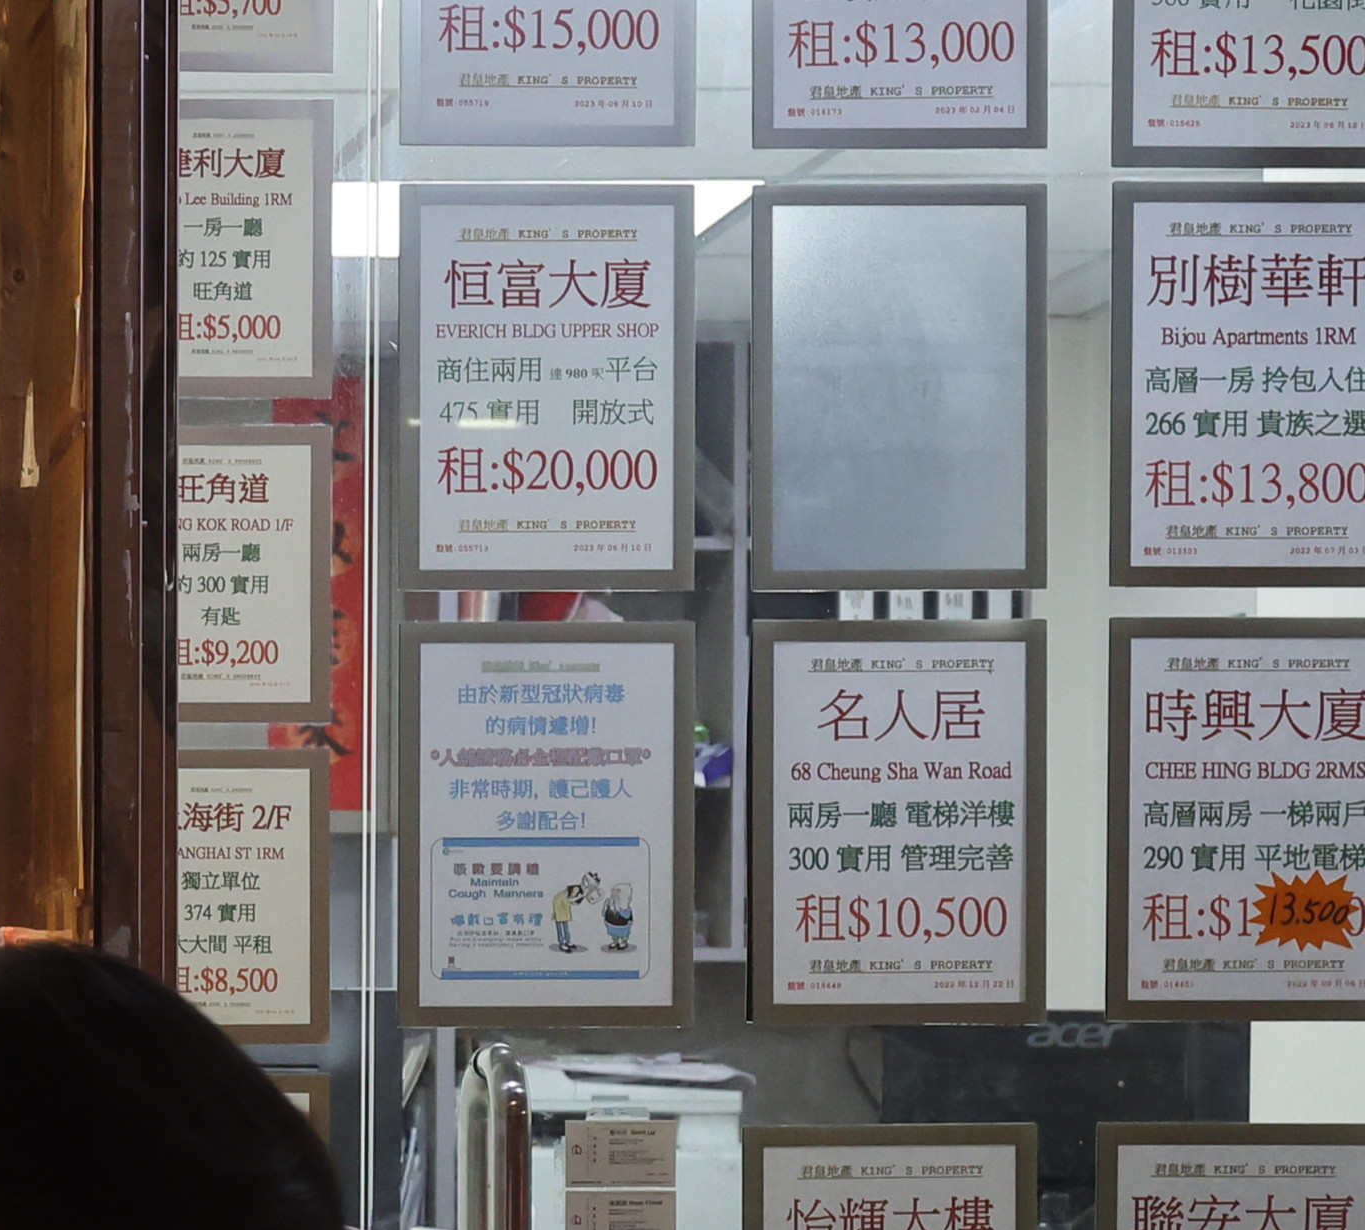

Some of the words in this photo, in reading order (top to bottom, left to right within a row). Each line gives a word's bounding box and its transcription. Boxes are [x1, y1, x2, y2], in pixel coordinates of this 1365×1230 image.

[577, 75, 638, 86] PROPERTY
[444, 259, 651, 309] 恒富大廈
[435, 323, 507, 339] EVERICH
[512, 323, 556, 339] BLDG
[561, 323, 611, 338] UPPER
[617, 323, 659, 339] SHOP
[1161, 327, 1206, 347] Bijou
[1213, 327, 1308, 348] Apartments
[1315, 327, 1356, 345] 1RM
[1145, 412, 1185, 435] 266
[1193, 410, 1247, 437] 實用
[818, 688, 985, 742] 名人居
[791, 763, 811, 781] 68
[816, 762, 882, 784] Cheung
[887, 762, 919, 780] Sha
[925, 763, 963, 780] Wan
[969, 762, 1012, 780] Road
[1145, 762, 1196, 779] CHEE
[1202, 761, 1251, 779] HING
[1257, 761, 1311, 779] BLDG
[470, 878, 519, 888] Maintain
[449, 889, 487, 900] Cough
[494, 889, 543, 899] Manners
[1027, 1022, 1127, 1048] acer
